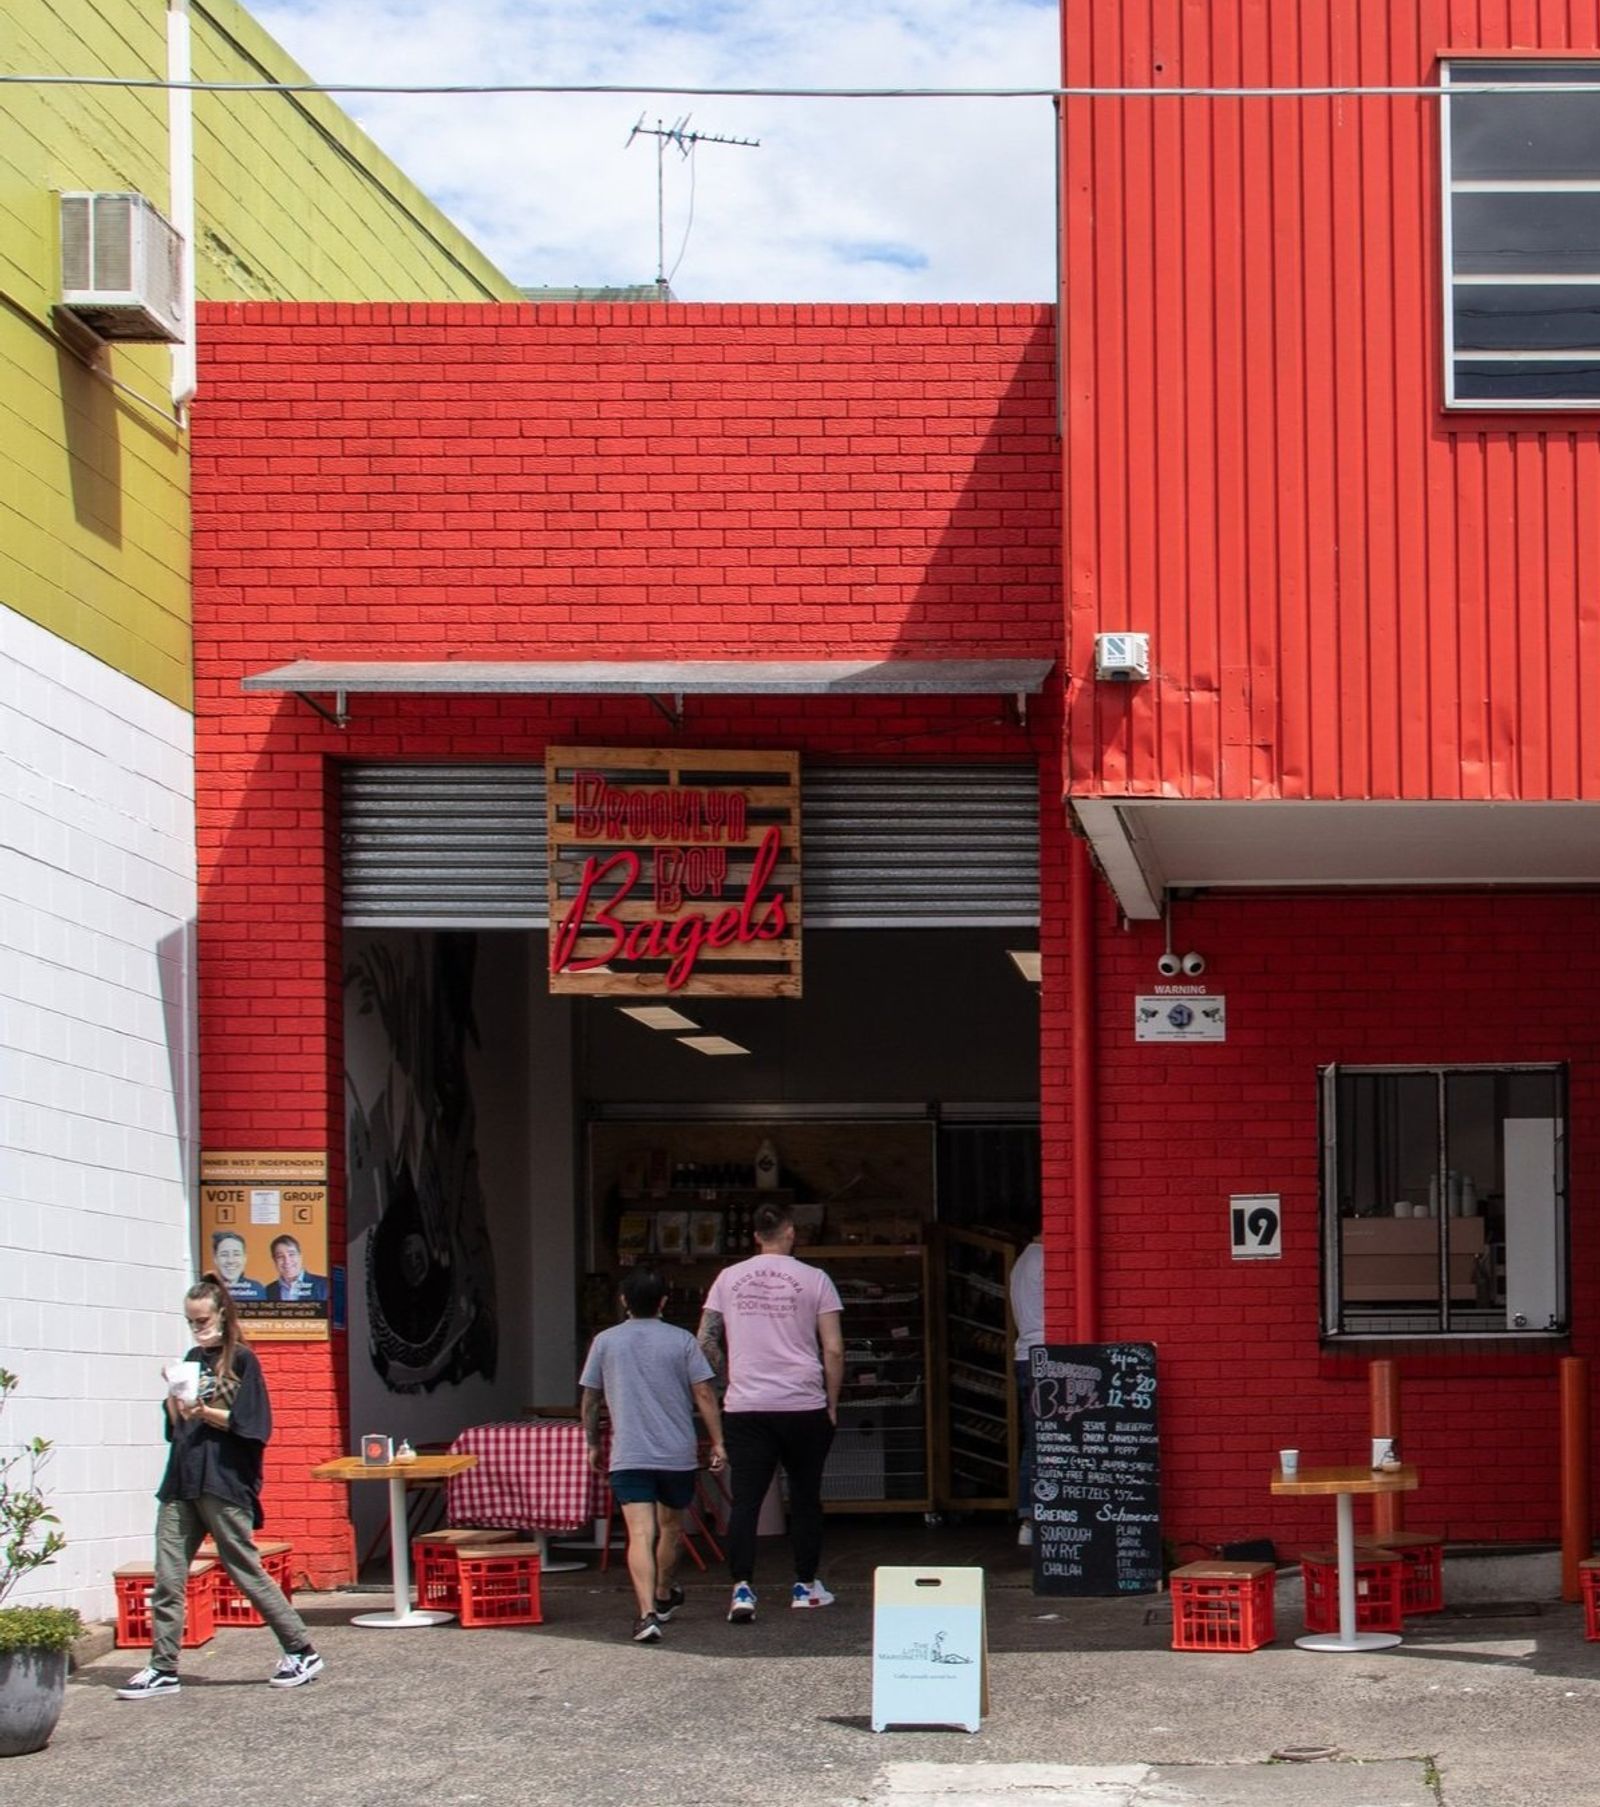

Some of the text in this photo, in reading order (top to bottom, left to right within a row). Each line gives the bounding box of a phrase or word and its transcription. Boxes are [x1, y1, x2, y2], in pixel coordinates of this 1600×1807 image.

[654, 846, 727, 914] BOY
[551, 825, 788, 991] Bagels
[1154, 985, 1207, 994] WARNING
[206, 1190, 245, 1202] VOTE
[283, 1191, 324, 1201] GROUP
[222, 1208, 228, 1220] 1
[298, 1208, 308, 1220] C
[1232, 1207, 1278, 1246] 19
[1111, 1372, 1121, 1386] 6
[1106, 1389, 1124, 1407] 12
[1035, 1421, 1057, 1431] PLAIN
[1062, 1485, 1111, 1501] PRETZELS
[1116, 1525, 1142, 1536] PLAIN
[1041, 1544, 1083, 1560] NY RYE
[1042, 1562, 1082, 1576] CHALLAH
